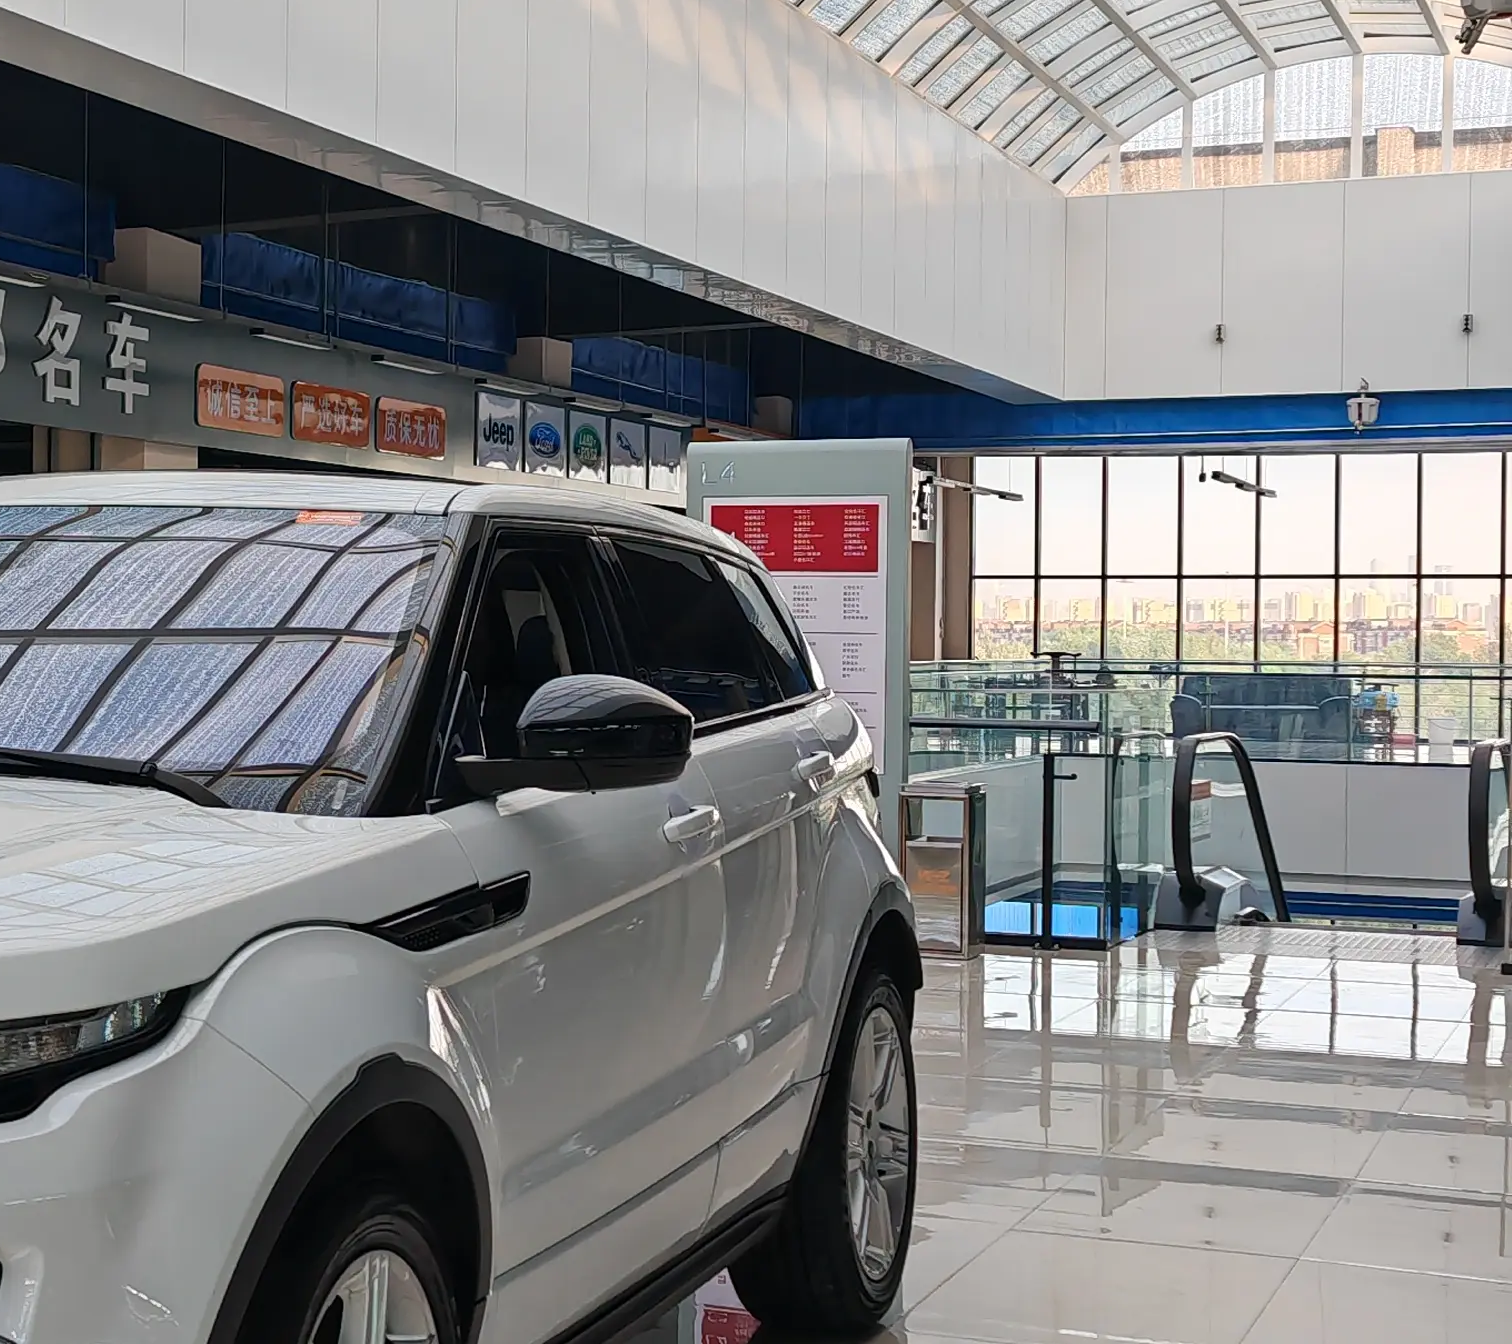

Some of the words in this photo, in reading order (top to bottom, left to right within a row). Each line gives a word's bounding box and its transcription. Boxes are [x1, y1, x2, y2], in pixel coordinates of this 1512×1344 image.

[207, 378, 277, 425] 诚信至上
[300, 392, 364, 437] 严选好车
[384, 408, 440, 450] 质保无忧
[482, 412, 515, 452] Jeep
[701, 461, 736, 485] L4
